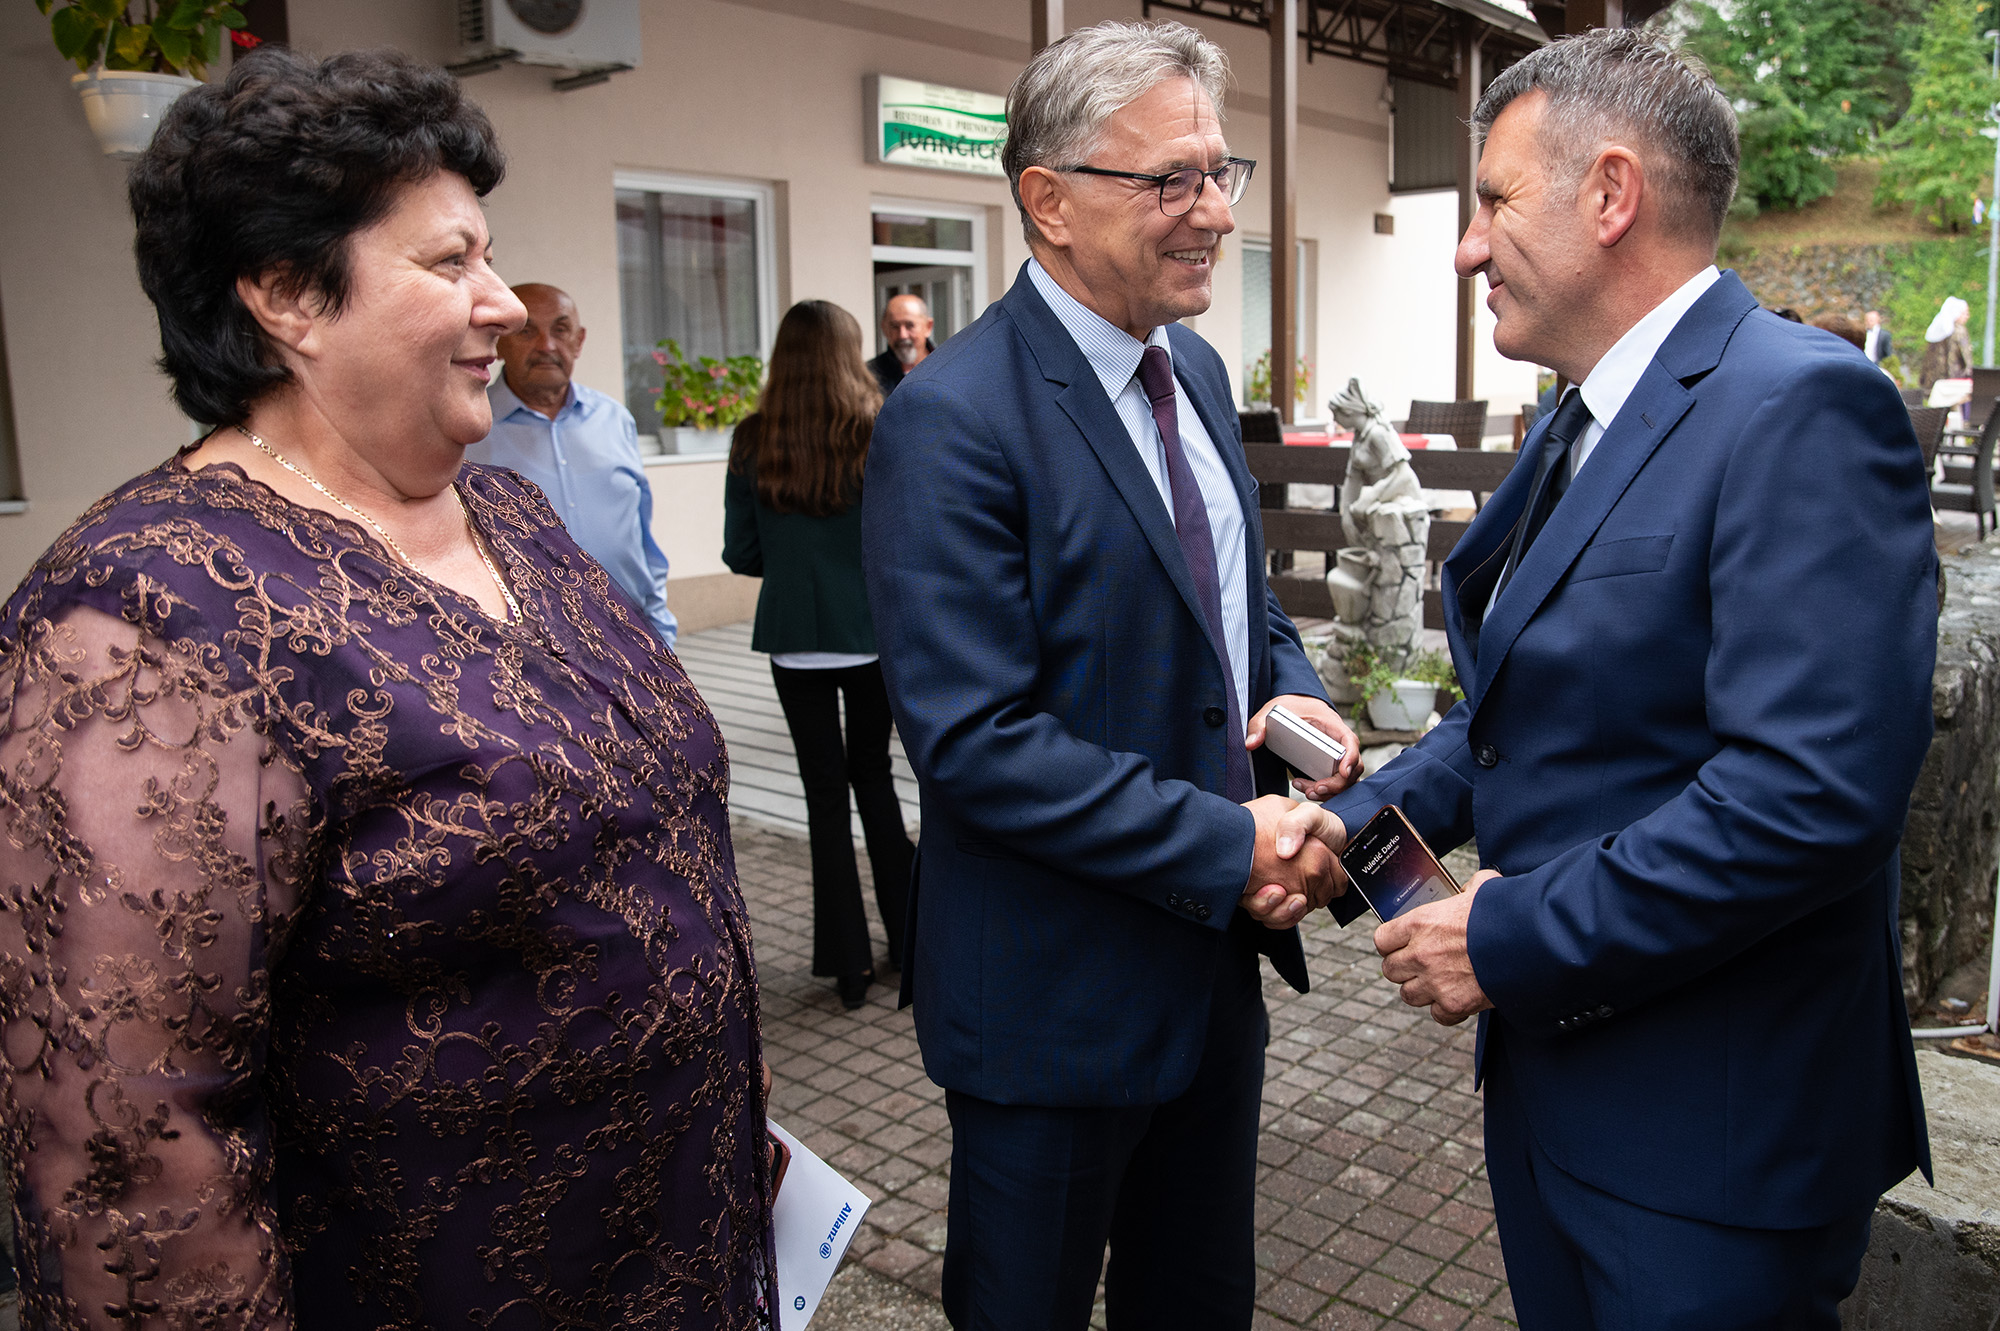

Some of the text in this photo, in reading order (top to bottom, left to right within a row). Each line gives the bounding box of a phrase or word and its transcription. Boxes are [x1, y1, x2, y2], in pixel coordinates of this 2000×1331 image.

[1361, 852, 1384, 874] Vuletić
[1381, 834, 1400, 855] Darko
[827, 1202, 853, 1243] Allianz
